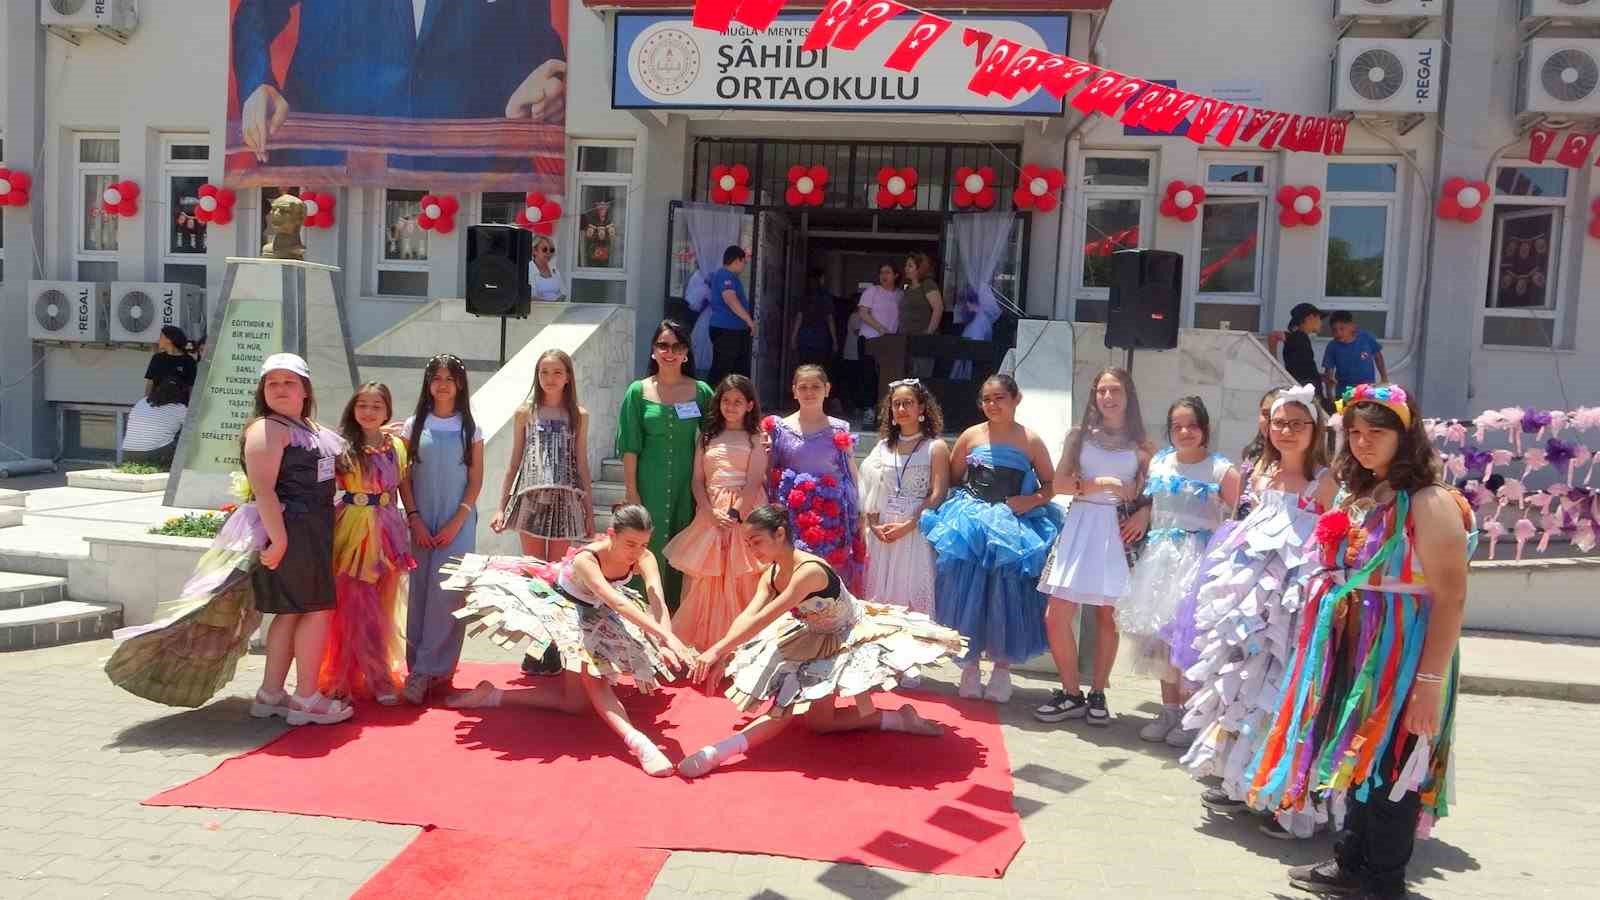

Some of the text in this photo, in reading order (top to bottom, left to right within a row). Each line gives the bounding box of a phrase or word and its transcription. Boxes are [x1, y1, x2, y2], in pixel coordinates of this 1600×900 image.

[716, 76, 920, 100] ORTAOKULU
[1416, 48, 1432, 98] REGAL
[79, 289, 88, 331] REGAL
